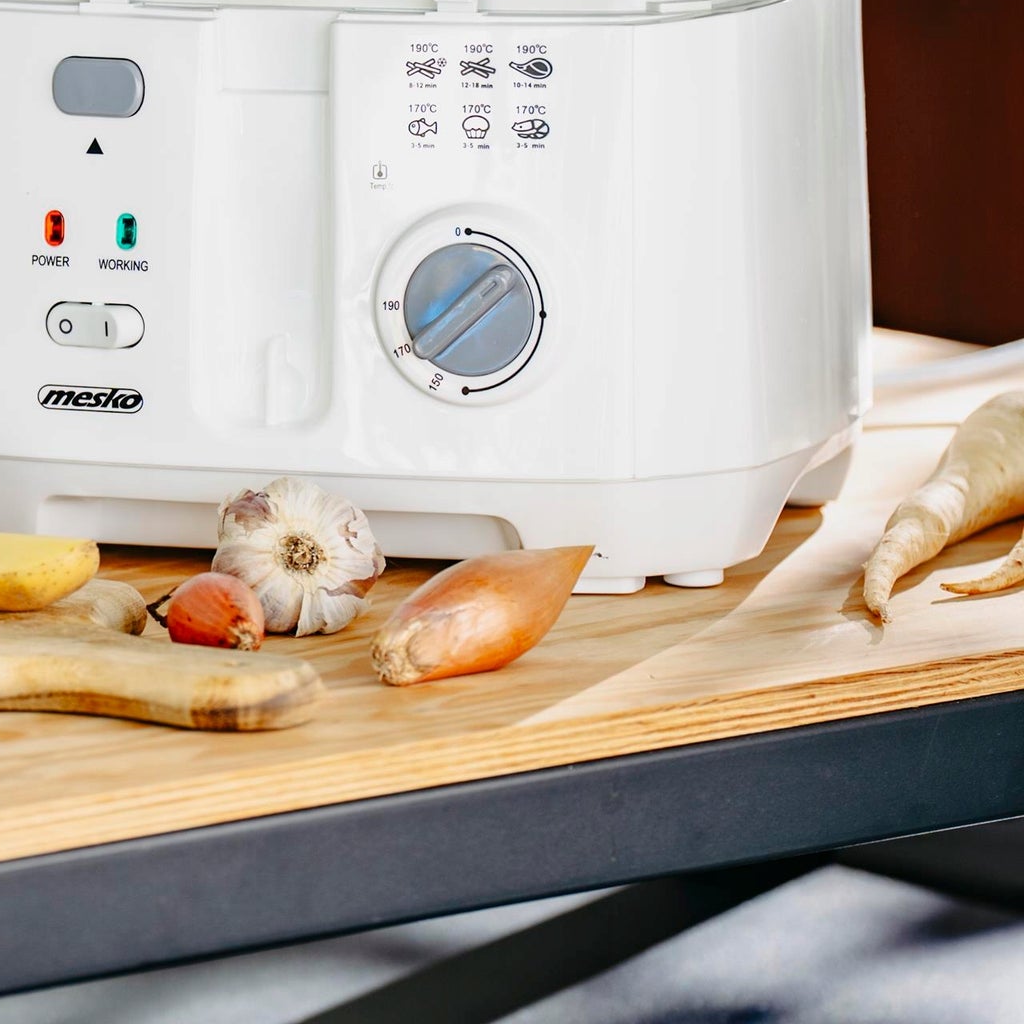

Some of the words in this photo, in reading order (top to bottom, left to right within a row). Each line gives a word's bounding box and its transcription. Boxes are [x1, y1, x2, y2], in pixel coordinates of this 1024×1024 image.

[410, 42, 439, 53] 190°C
[464, 43, 493, 54] 190°C
[517, 44, 547, 54] 190°C
[408, 103, 437, 113] 170°C
[462, 104, 491, 114] 170°C
[516, 105, 546, 115] 170°C
[455, 227, 461, 236] 0
[31, 255, 70, 267] POWER
[98, 259, 149, 271] WORKING
[382, 300, 400, 310] 190
[393, 343, 411, 358] 170
[428, 372, 444, 392] 150
[41, 388, 143, 409] mesko
